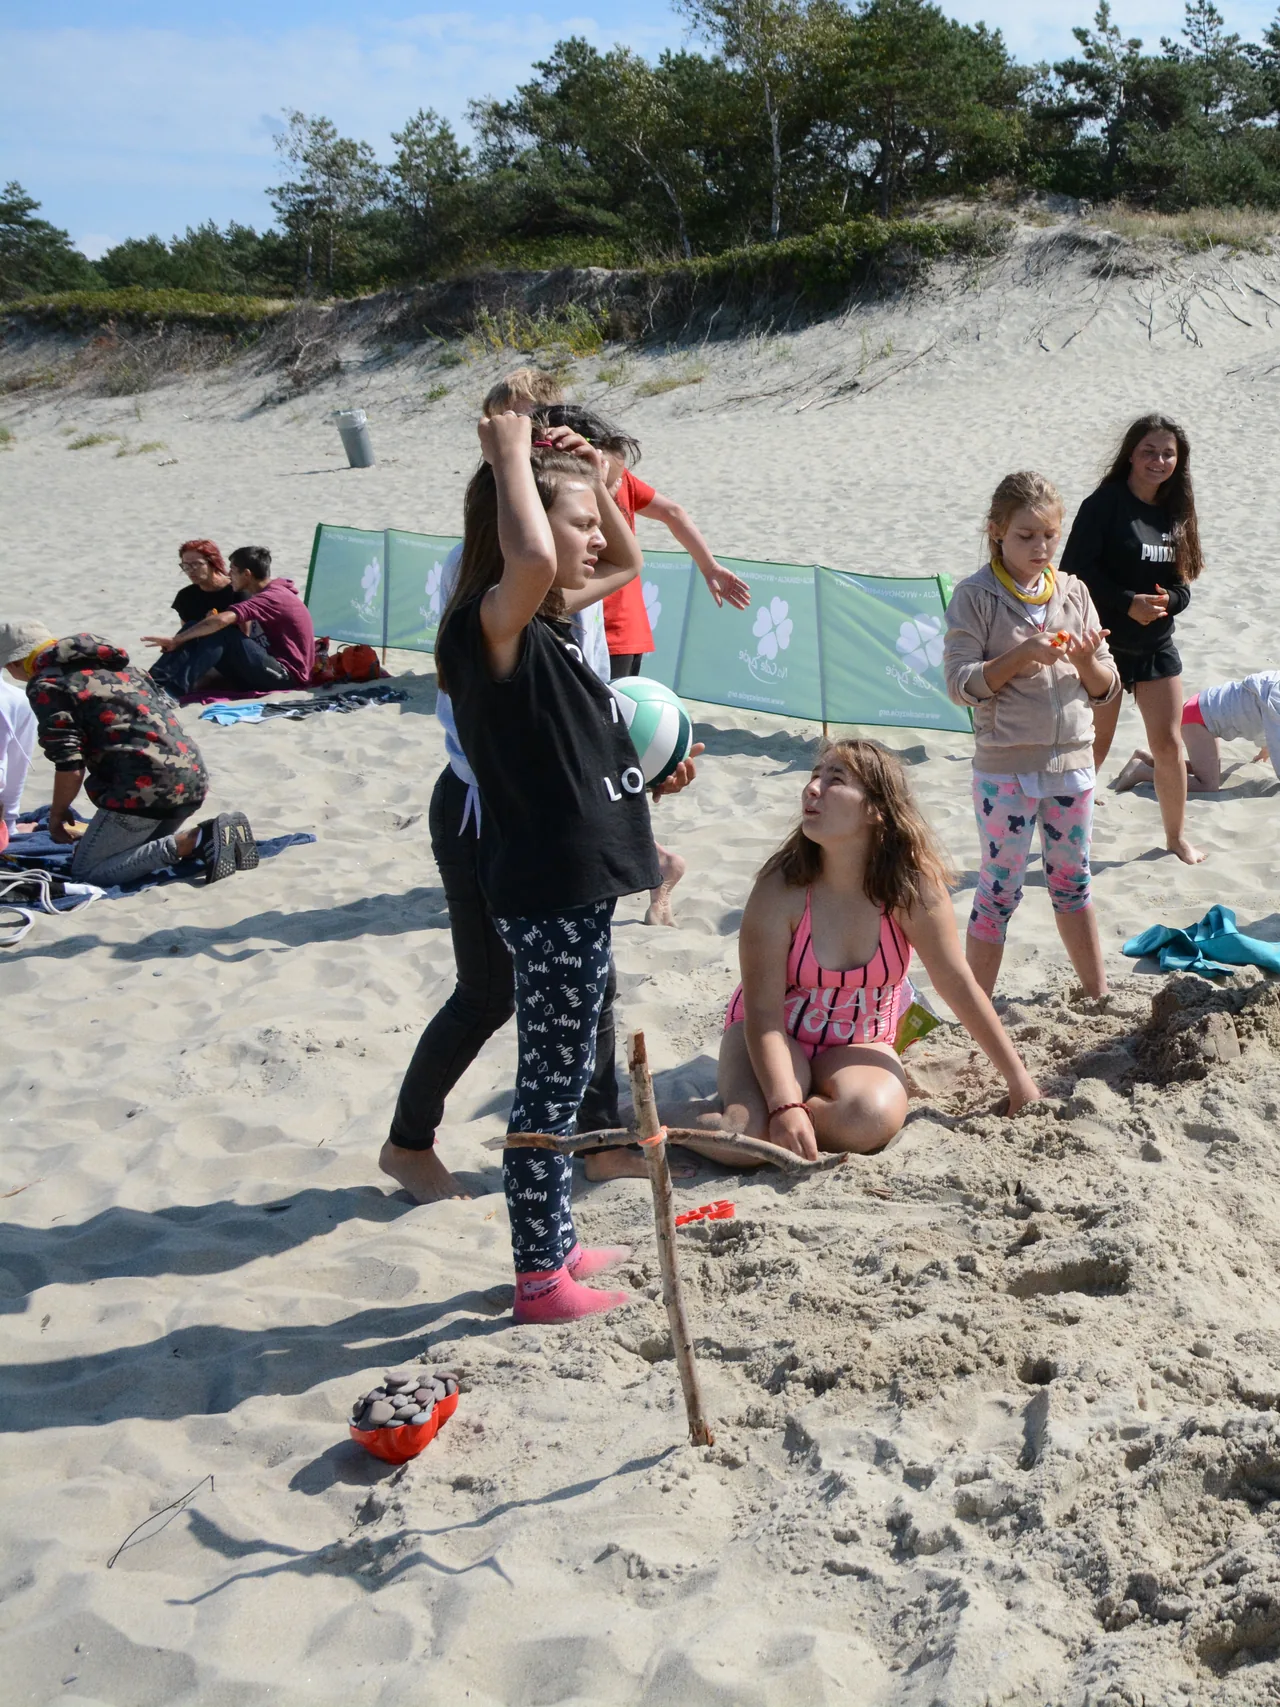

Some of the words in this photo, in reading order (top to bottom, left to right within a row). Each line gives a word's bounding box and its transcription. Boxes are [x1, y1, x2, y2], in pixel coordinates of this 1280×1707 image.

[557, 917, 581, 944] Magic
[527, 960, 550, 974] Seek
[552, 950, 582, 969] Magic
[560, 983, 582, 1008] Magic
[527, 1020, 549, 1033] Seek
[552, 1013, 581, 1030] Magic
[556, 1043, 576, 1066] Magic
[520, 1076, 540, 1091] Seek
[544, 1070, 572, 1087] Magic
[526, 1158, 549, 1181] Magic
[516, 1187, 548, 1202] Magic
[525, 1217, 549, 1238] Magic
